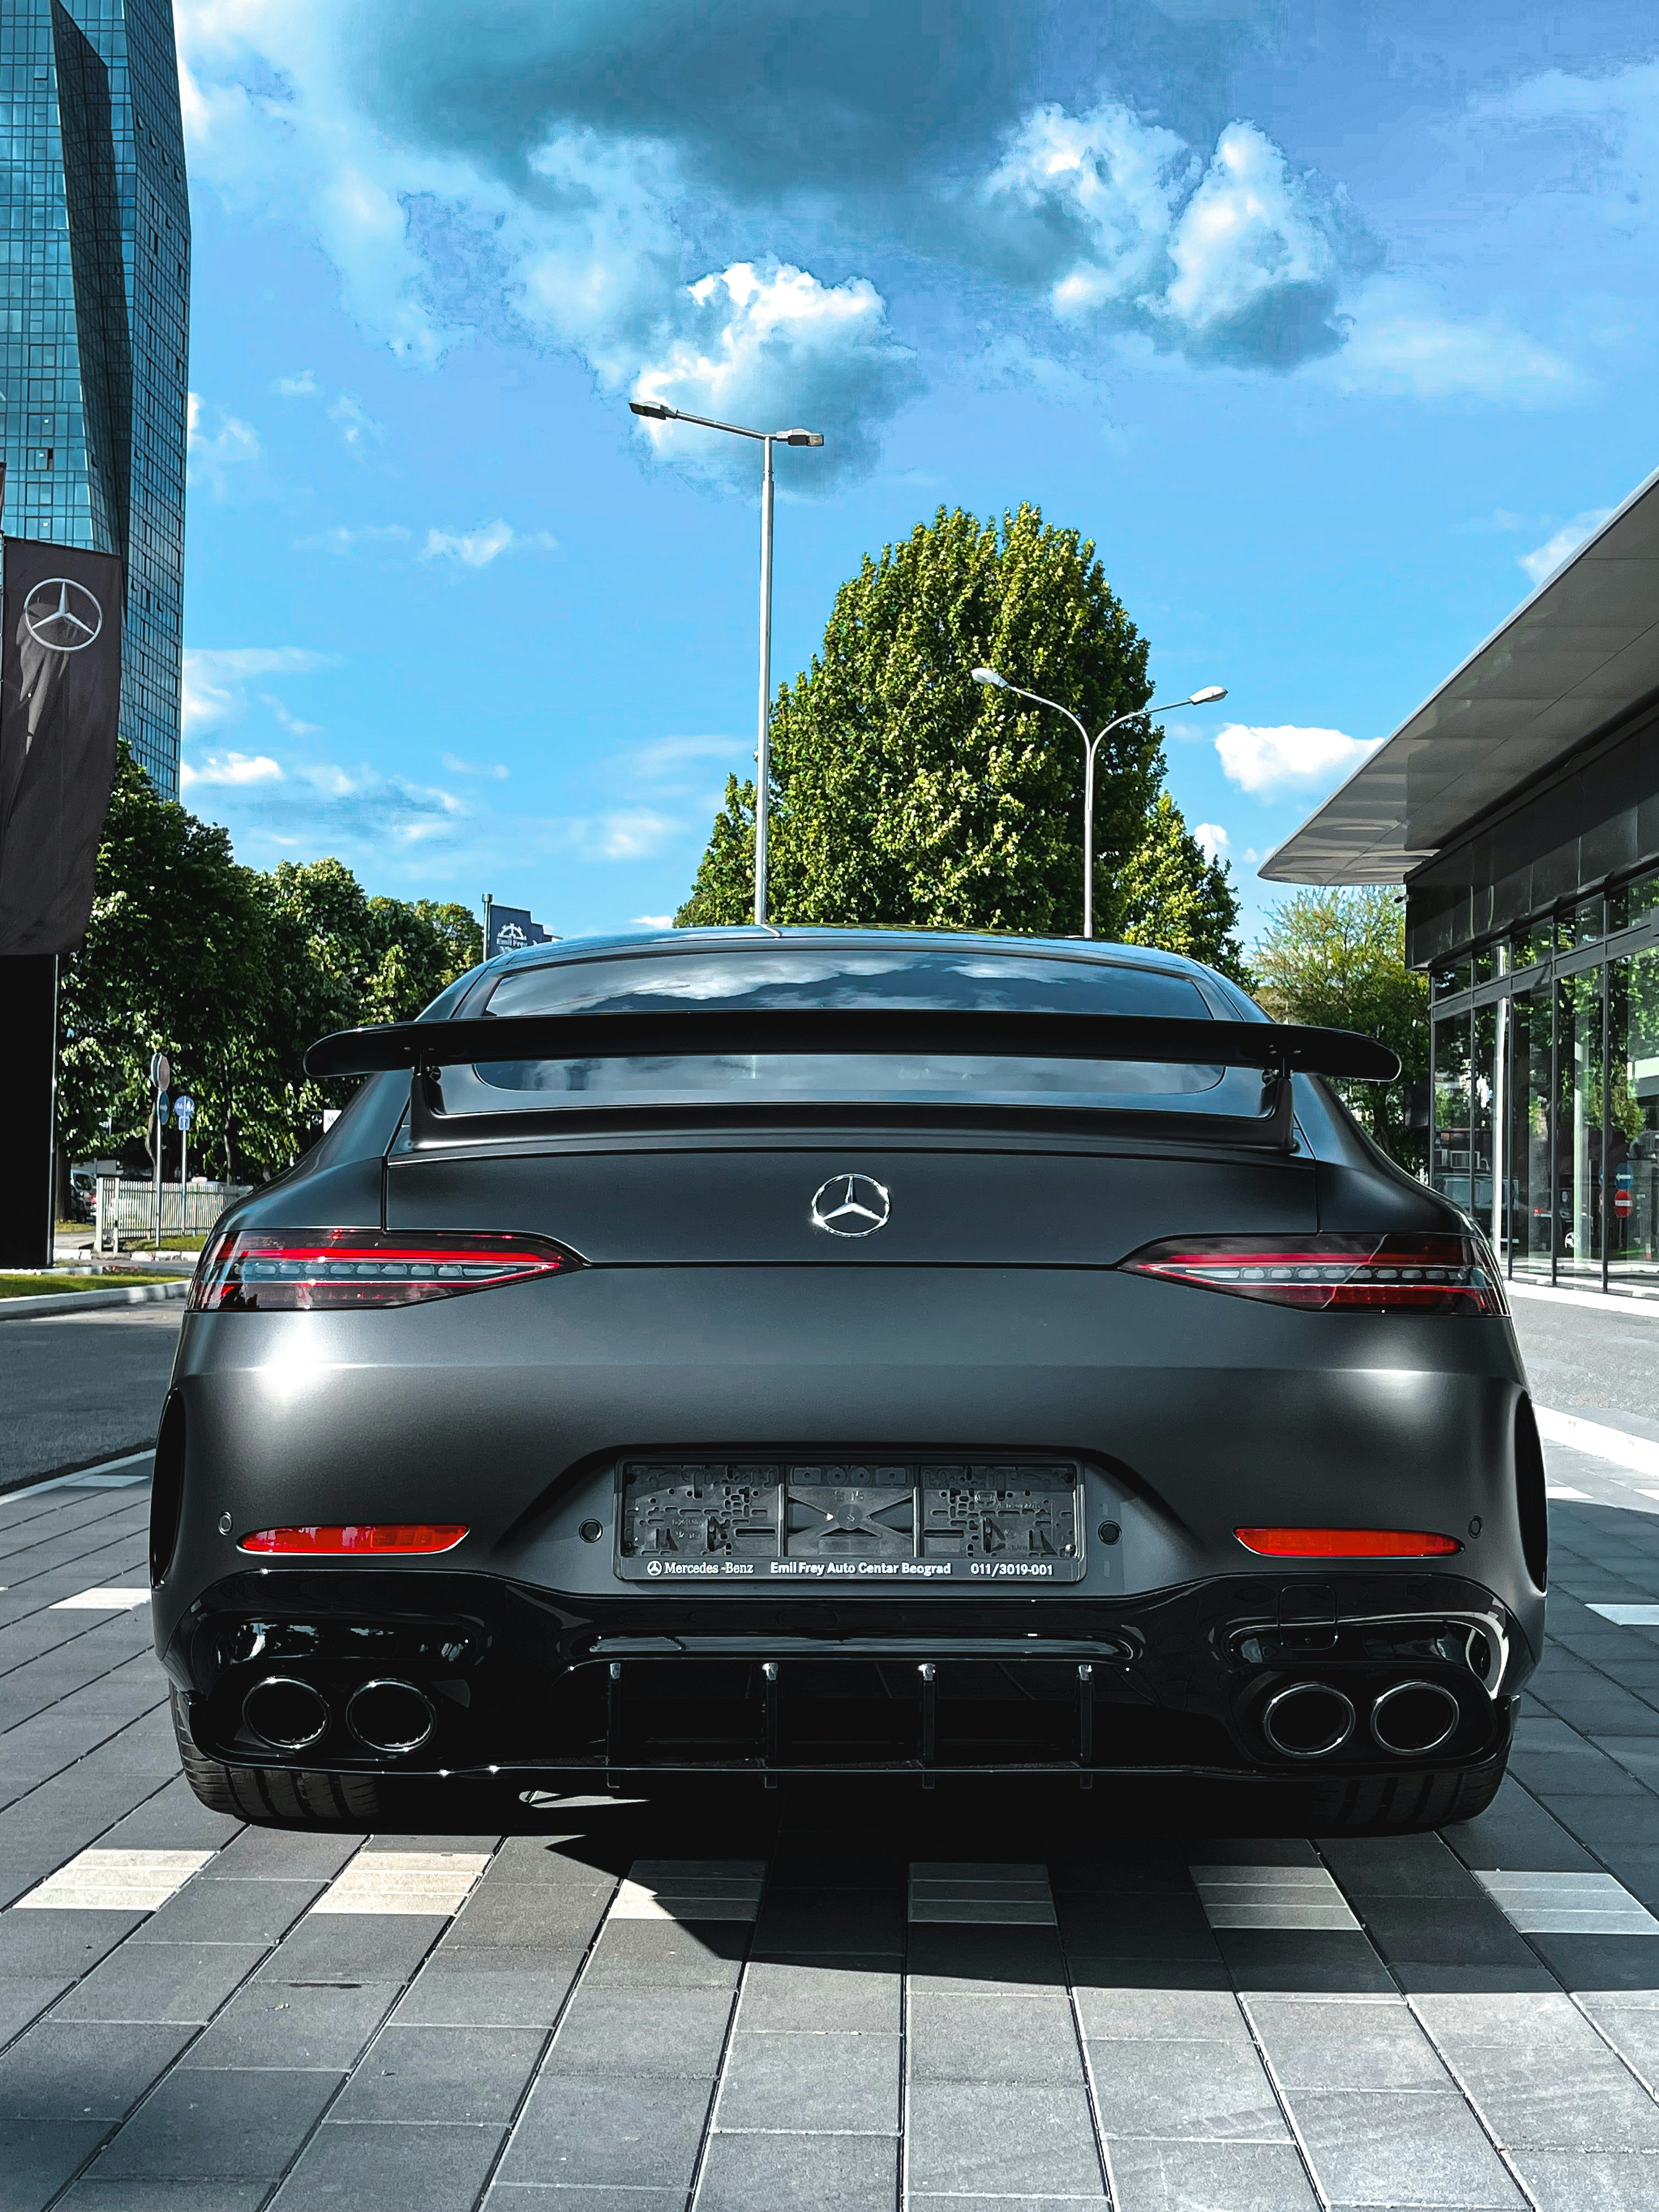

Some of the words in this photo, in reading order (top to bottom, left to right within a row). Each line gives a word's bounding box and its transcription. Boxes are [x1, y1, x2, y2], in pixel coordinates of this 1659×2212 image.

[770, 1561, 797, 1573] Emil
[798, 1561, 825, 1576] Frey
[827, 1562, 855, 1573] Auto
[858, 1562, 899, 1573] Centar
[902, 1562, 951, 1576] Beograd
[970, 1563, 1052, 1577] 011/3019-001
